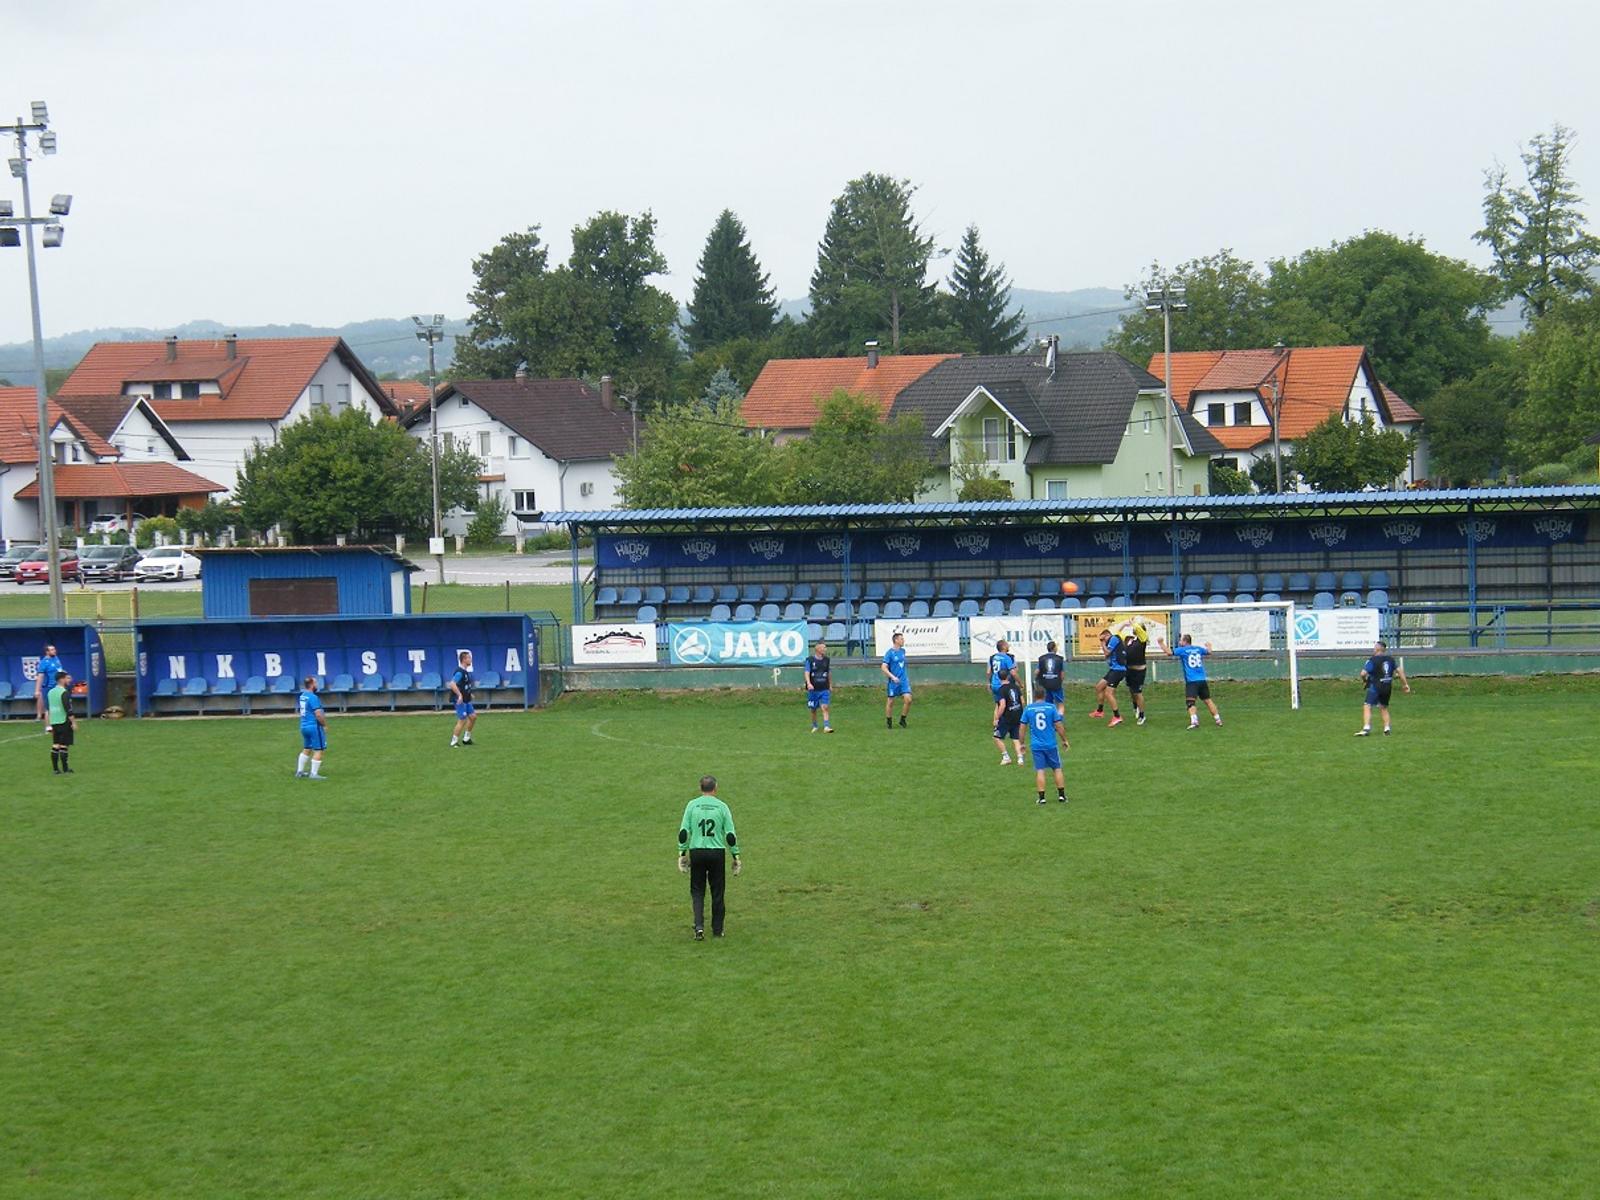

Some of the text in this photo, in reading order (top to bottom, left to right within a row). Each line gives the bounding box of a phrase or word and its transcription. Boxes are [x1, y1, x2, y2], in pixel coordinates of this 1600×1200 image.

[720, 630, 804, 658] JAKO
[1036, 712, 1046, 730] 6
[698, 818, 715, 837] 12
